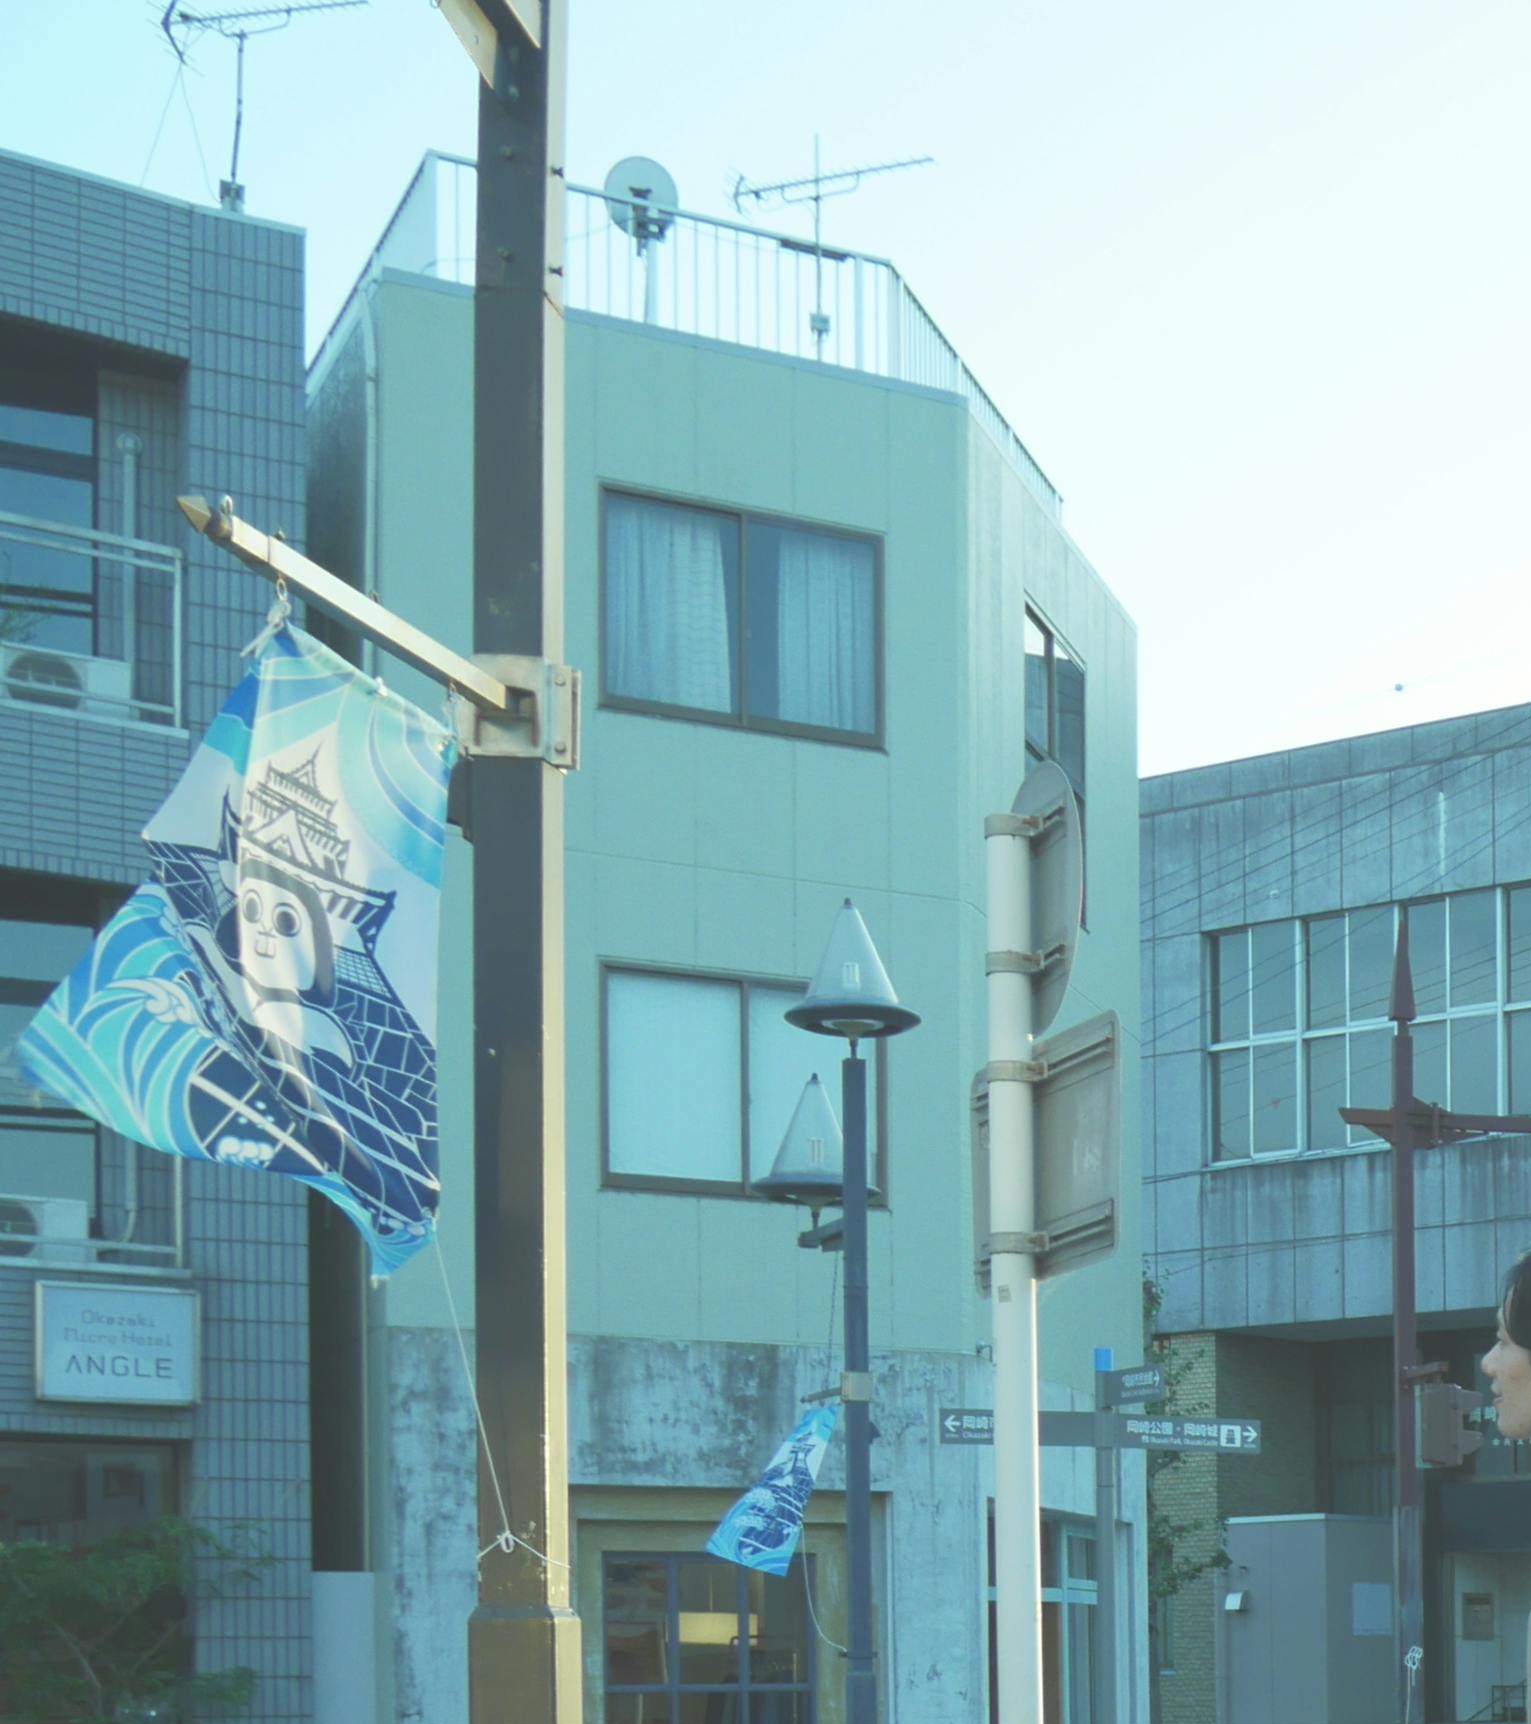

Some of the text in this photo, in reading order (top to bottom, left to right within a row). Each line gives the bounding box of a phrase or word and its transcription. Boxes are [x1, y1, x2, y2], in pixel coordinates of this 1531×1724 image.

[81, 1308, 156, 1327] Okazaki
[64, 1327, 118, 1344] Micro
[65, 1354, 174, 1379] ANGLE
